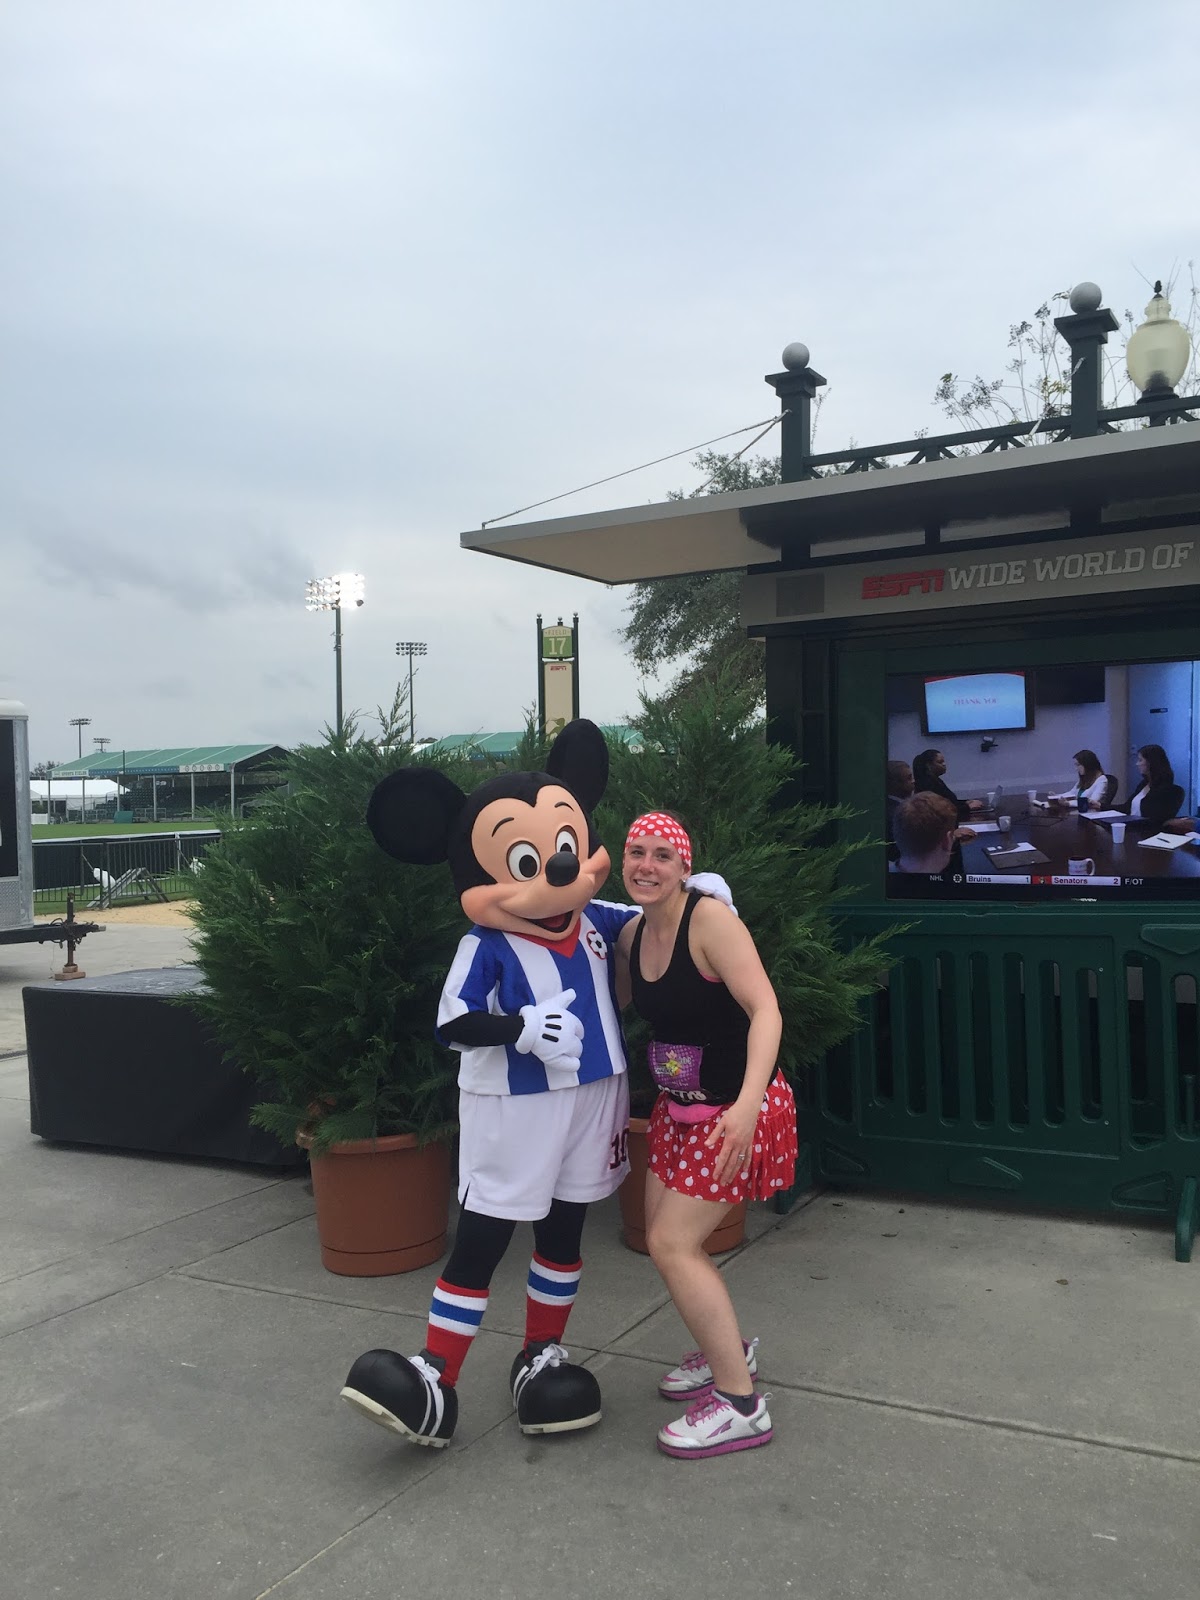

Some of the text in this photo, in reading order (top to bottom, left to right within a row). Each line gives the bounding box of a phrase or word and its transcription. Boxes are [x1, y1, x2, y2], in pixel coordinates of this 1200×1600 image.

[861, 542, 1194, 599] ESPN WIDE WORLD OF
[549, 637, 567, 655] 17
[968, 875, 992, 883] Bruins
